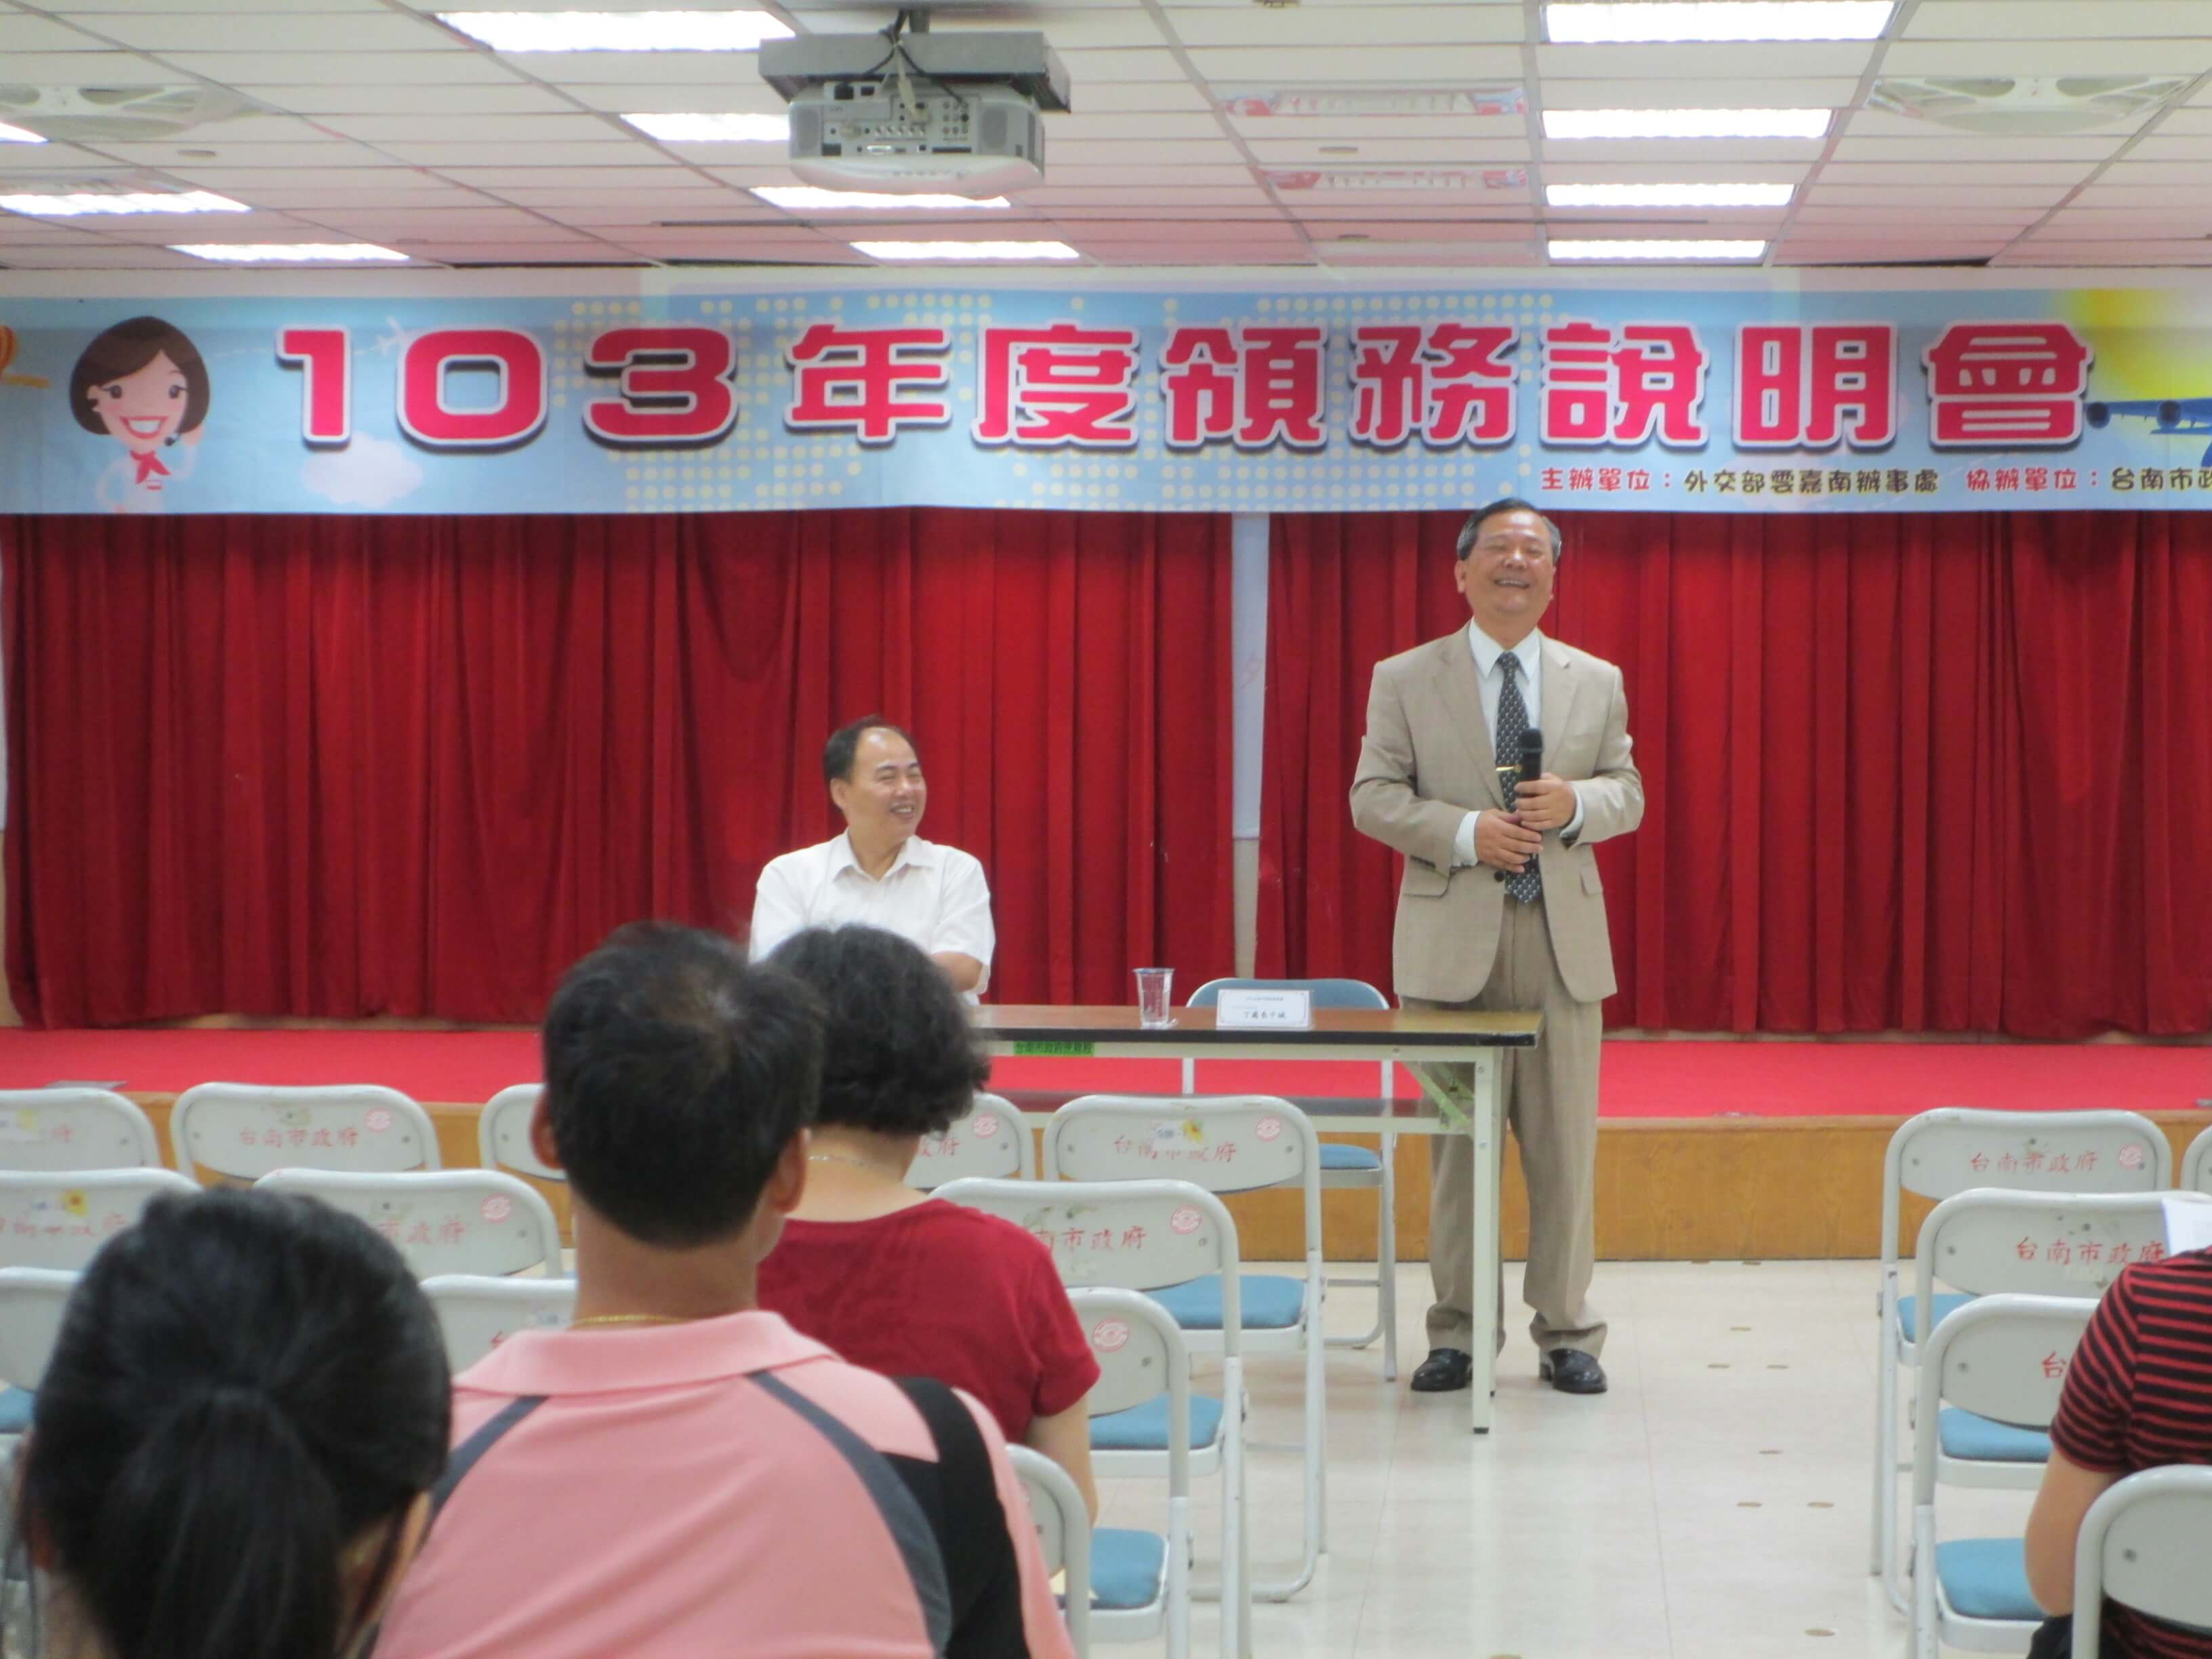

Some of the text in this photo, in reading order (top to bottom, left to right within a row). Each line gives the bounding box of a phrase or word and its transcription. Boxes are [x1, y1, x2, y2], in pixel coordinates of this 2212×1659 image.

[275, 322, 2095, 450] 103年度領務說明會
[1969, 1151, 2100, 1174] 台南市政府
[2015, 1236, 2166, 1265] 台南市政府
